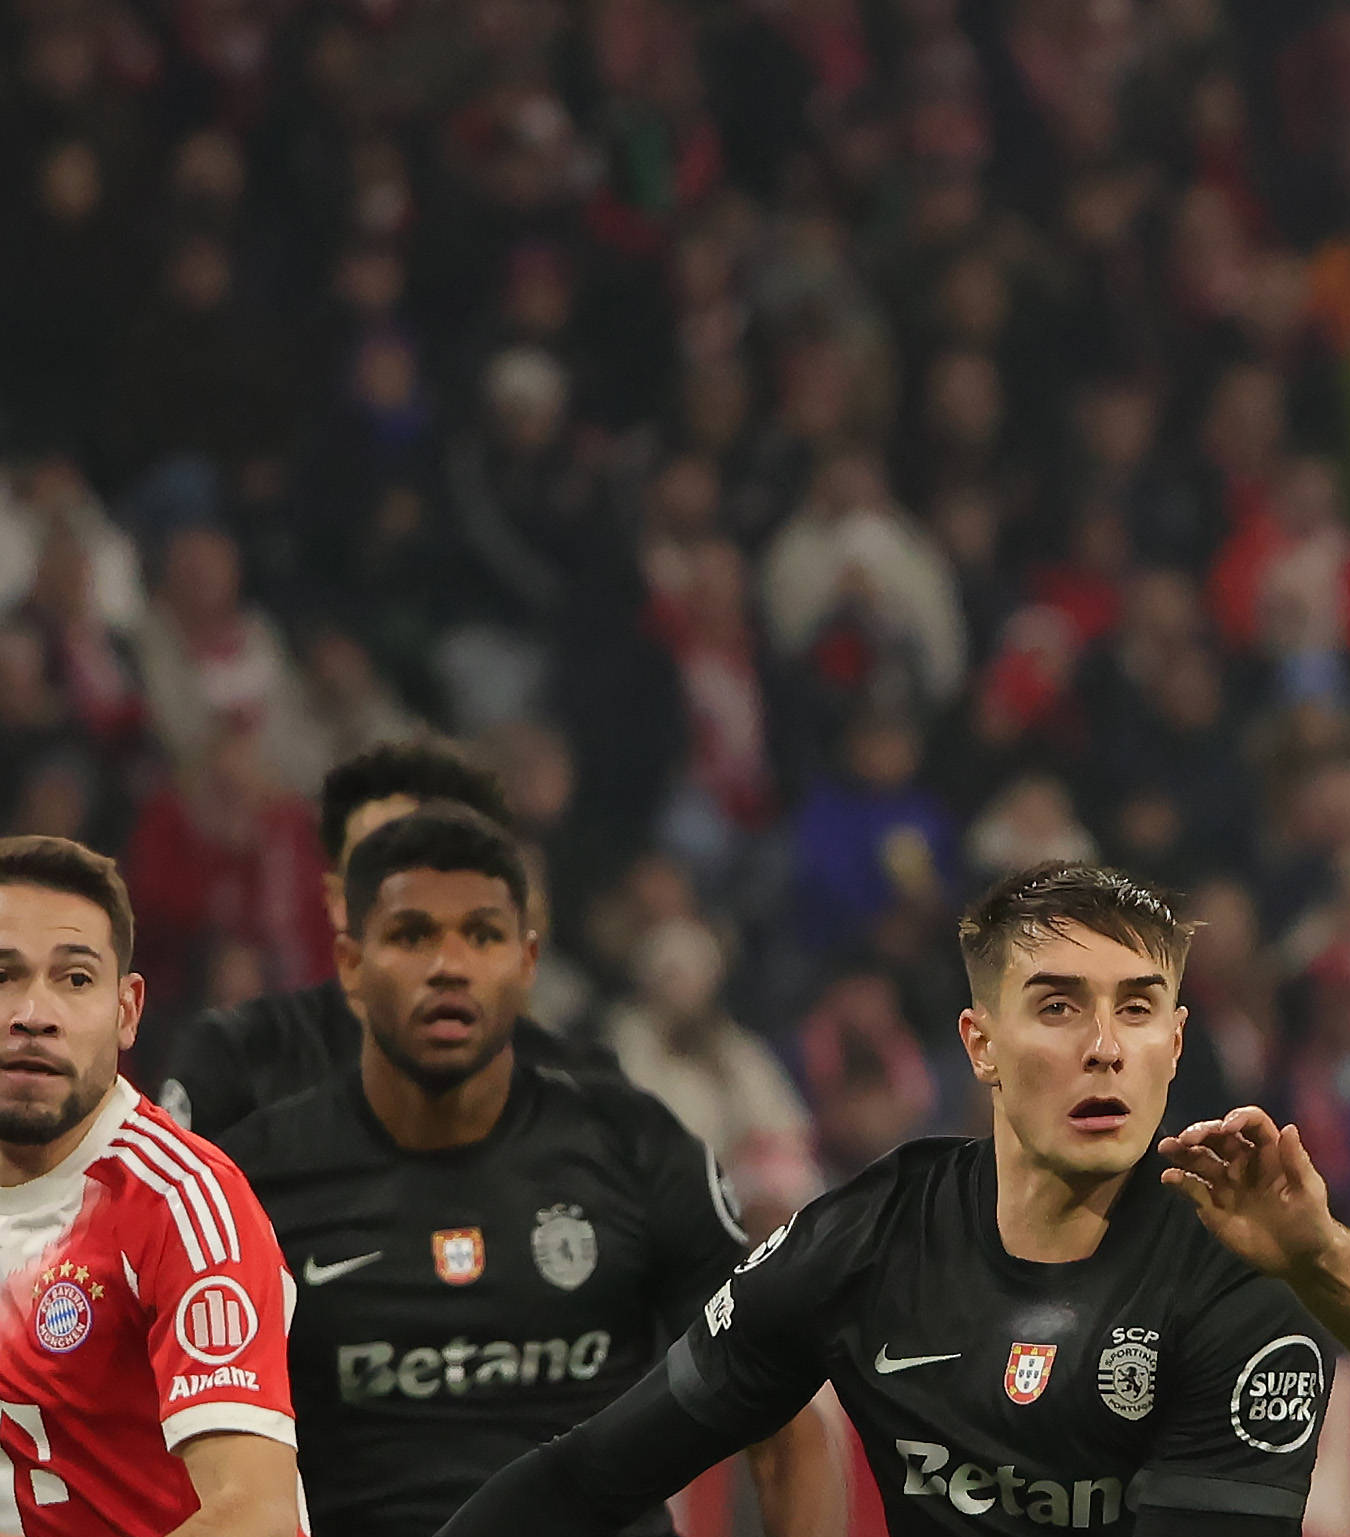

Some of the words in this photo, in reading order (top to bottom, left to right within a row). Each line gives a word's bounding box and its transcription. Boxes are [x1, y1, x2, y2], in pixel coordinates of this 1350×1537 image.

[51, 1284, 86, 1314] BAYERN
[1111, 1327, 1160, 1345] SCP
[337, 1330, 612, 1403] Betano
[1104, 1347, 1157, 1368] SPORTING
[168, 1366, 261, 1402] Allianz
[1248, 1398, 1314, 1422] BOCK
[895, 1438, 1124, 1529] Betan
